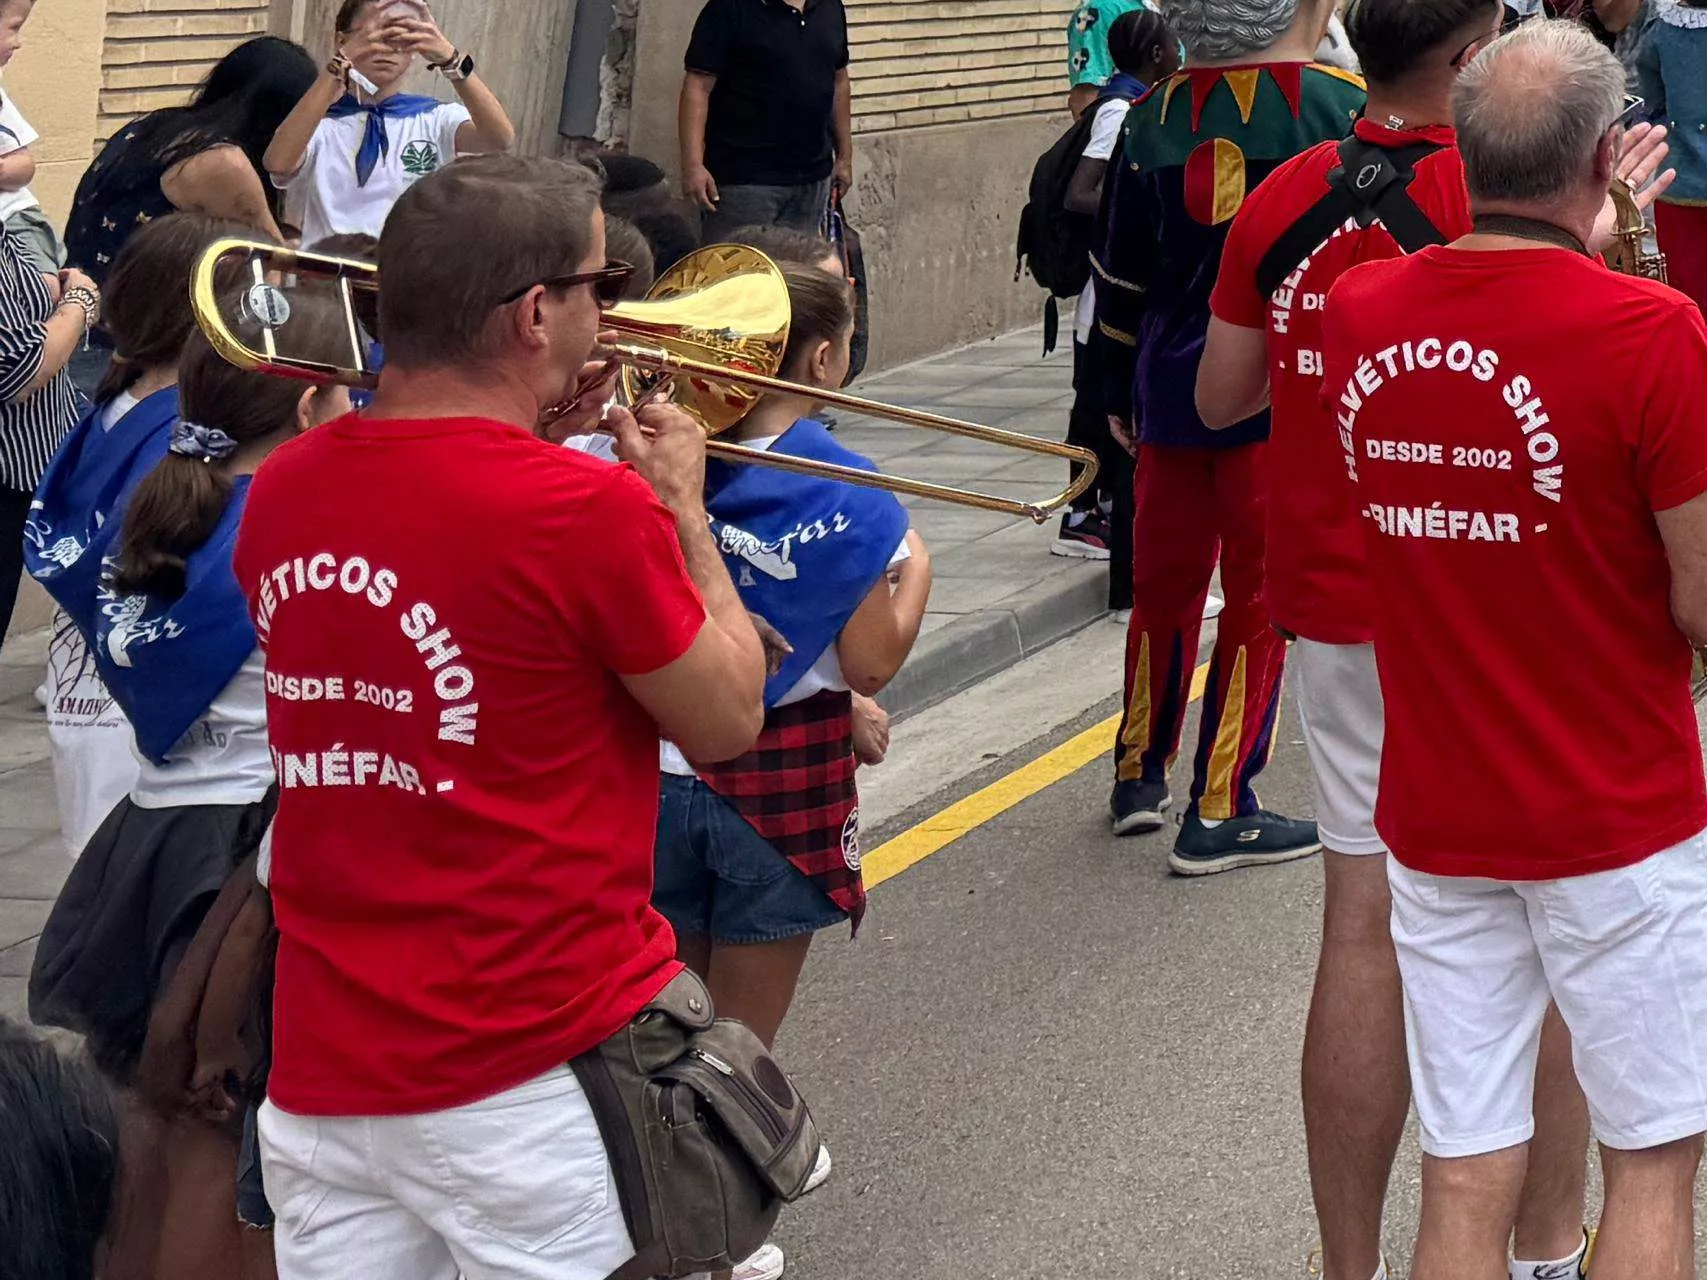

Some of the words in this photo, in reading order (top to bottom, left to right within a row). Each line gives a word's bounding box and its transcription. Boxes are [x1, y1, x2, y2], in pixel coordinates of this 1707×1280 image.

[1337, 337, 1500, 484] HELVÉTICOS
[1502, 374, 1564, 503] SHOW
[1365, 438, 1444, 465] DESDE
[1452, 446, 1512, 471] 2002
[353, 680, 413, 713] 2002
[400, 601, 479, 746] SHOW
[271, 742, 427, 796] INÉFAR
